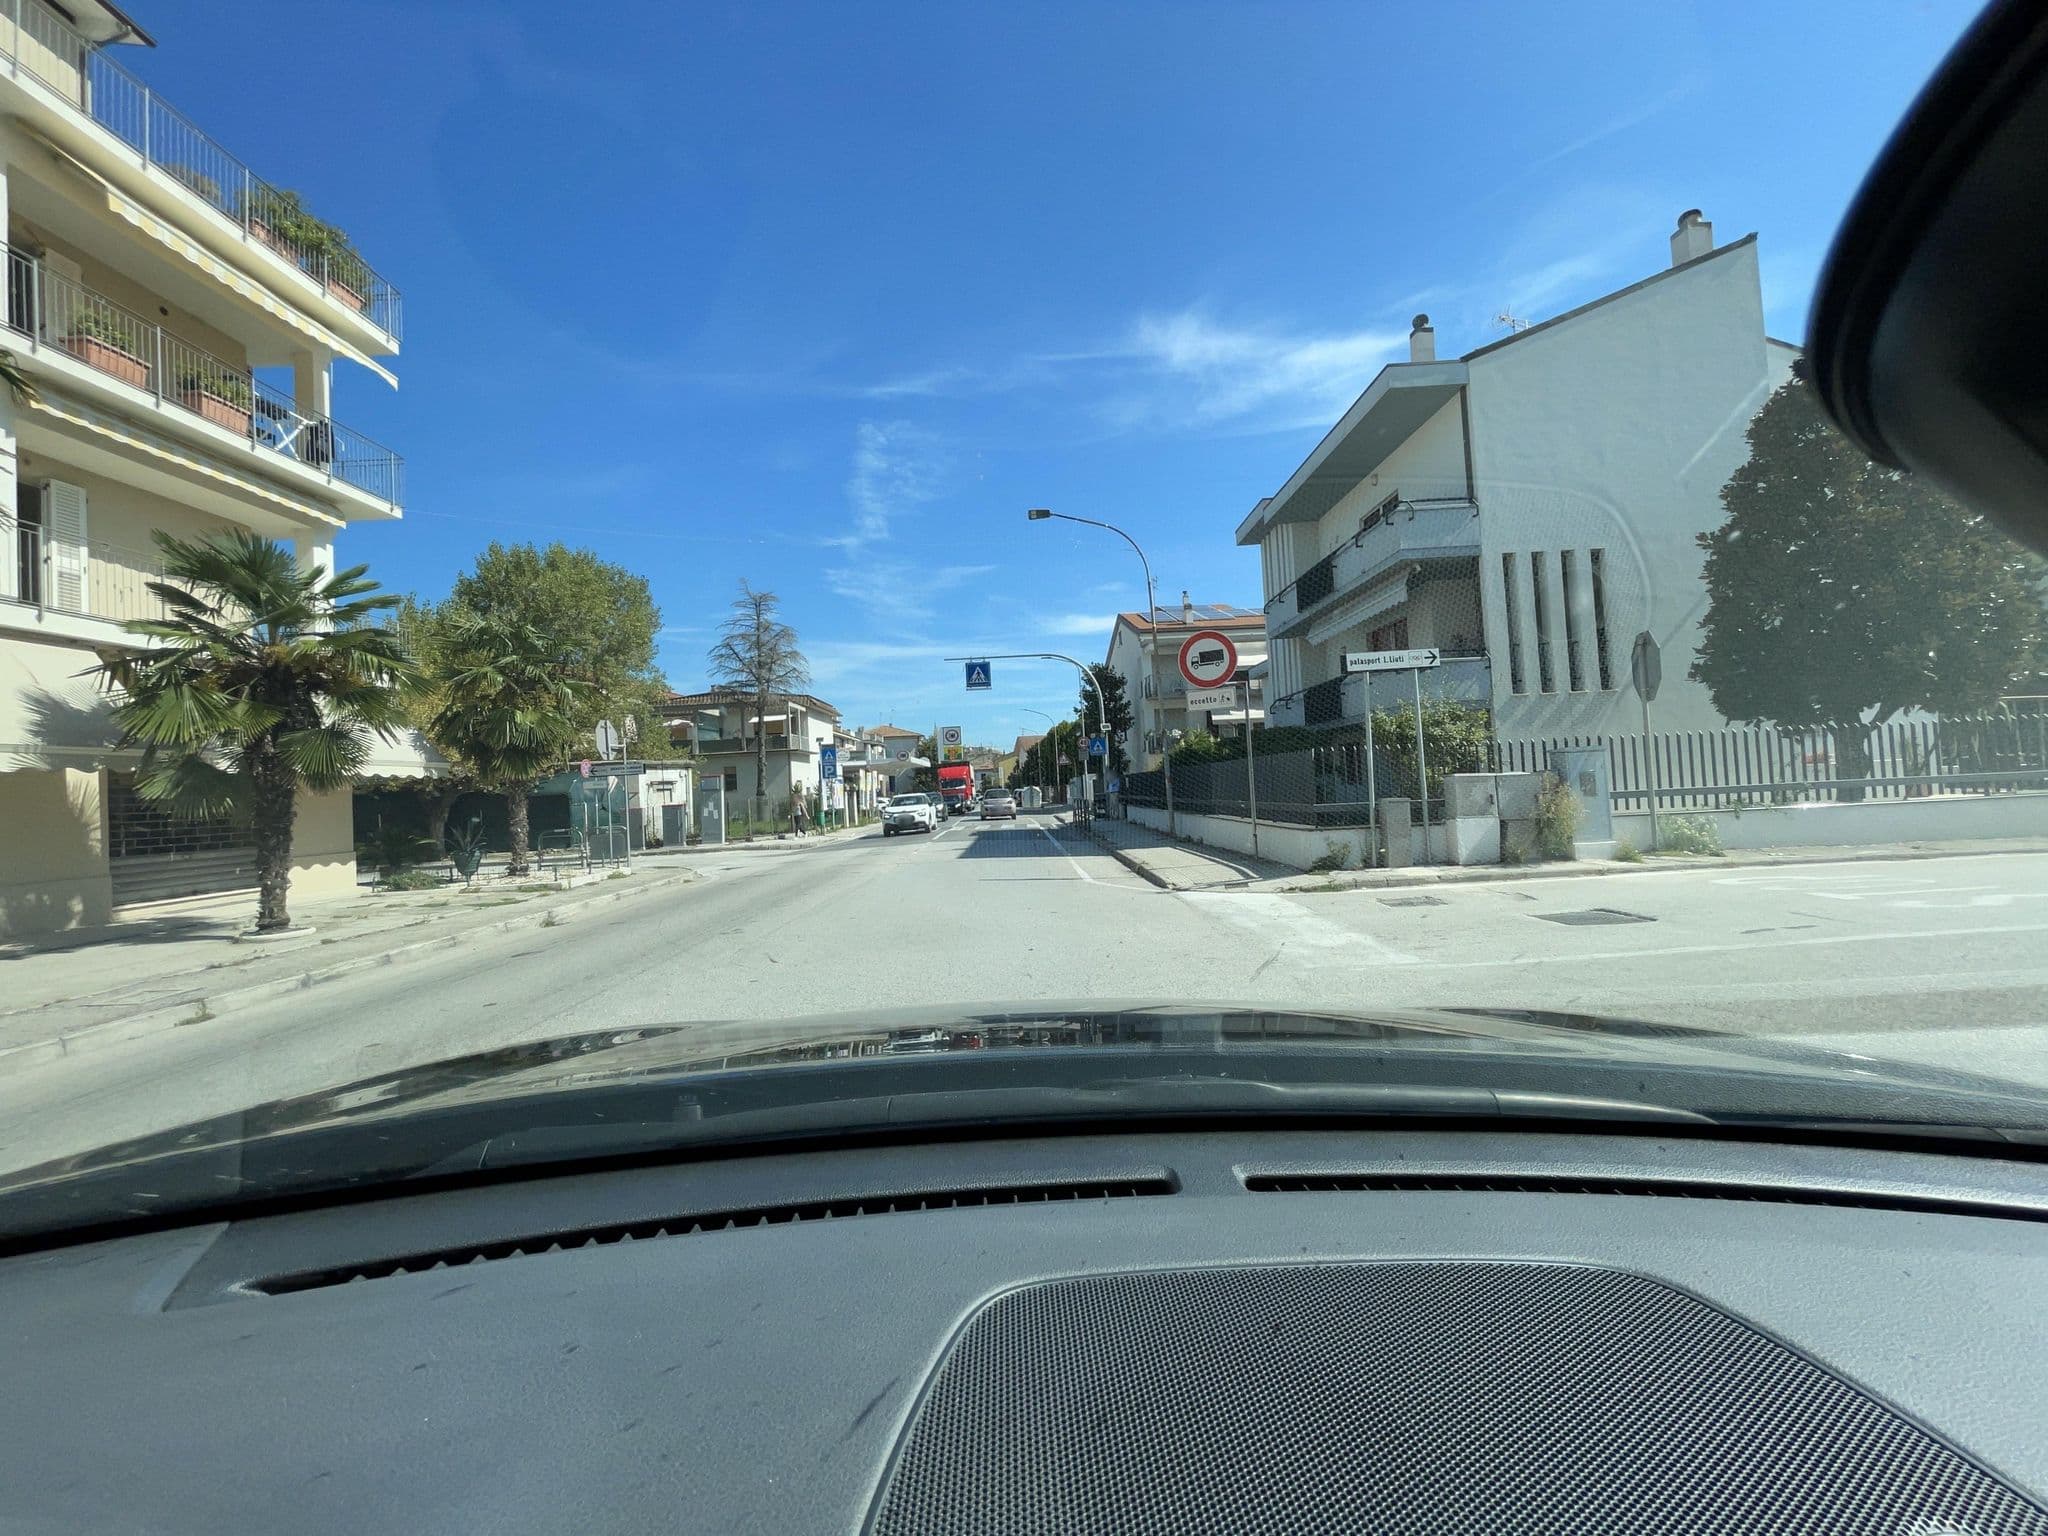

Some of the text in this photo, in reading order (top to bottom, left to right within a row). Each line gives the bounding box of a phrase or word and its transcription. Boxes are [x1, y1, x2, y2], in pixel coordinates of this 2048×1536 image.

[1349, 657, 1381, 667] palasport
[1190, 696, 1217, 705] eccetto
[824, 766, 834, 777] P
